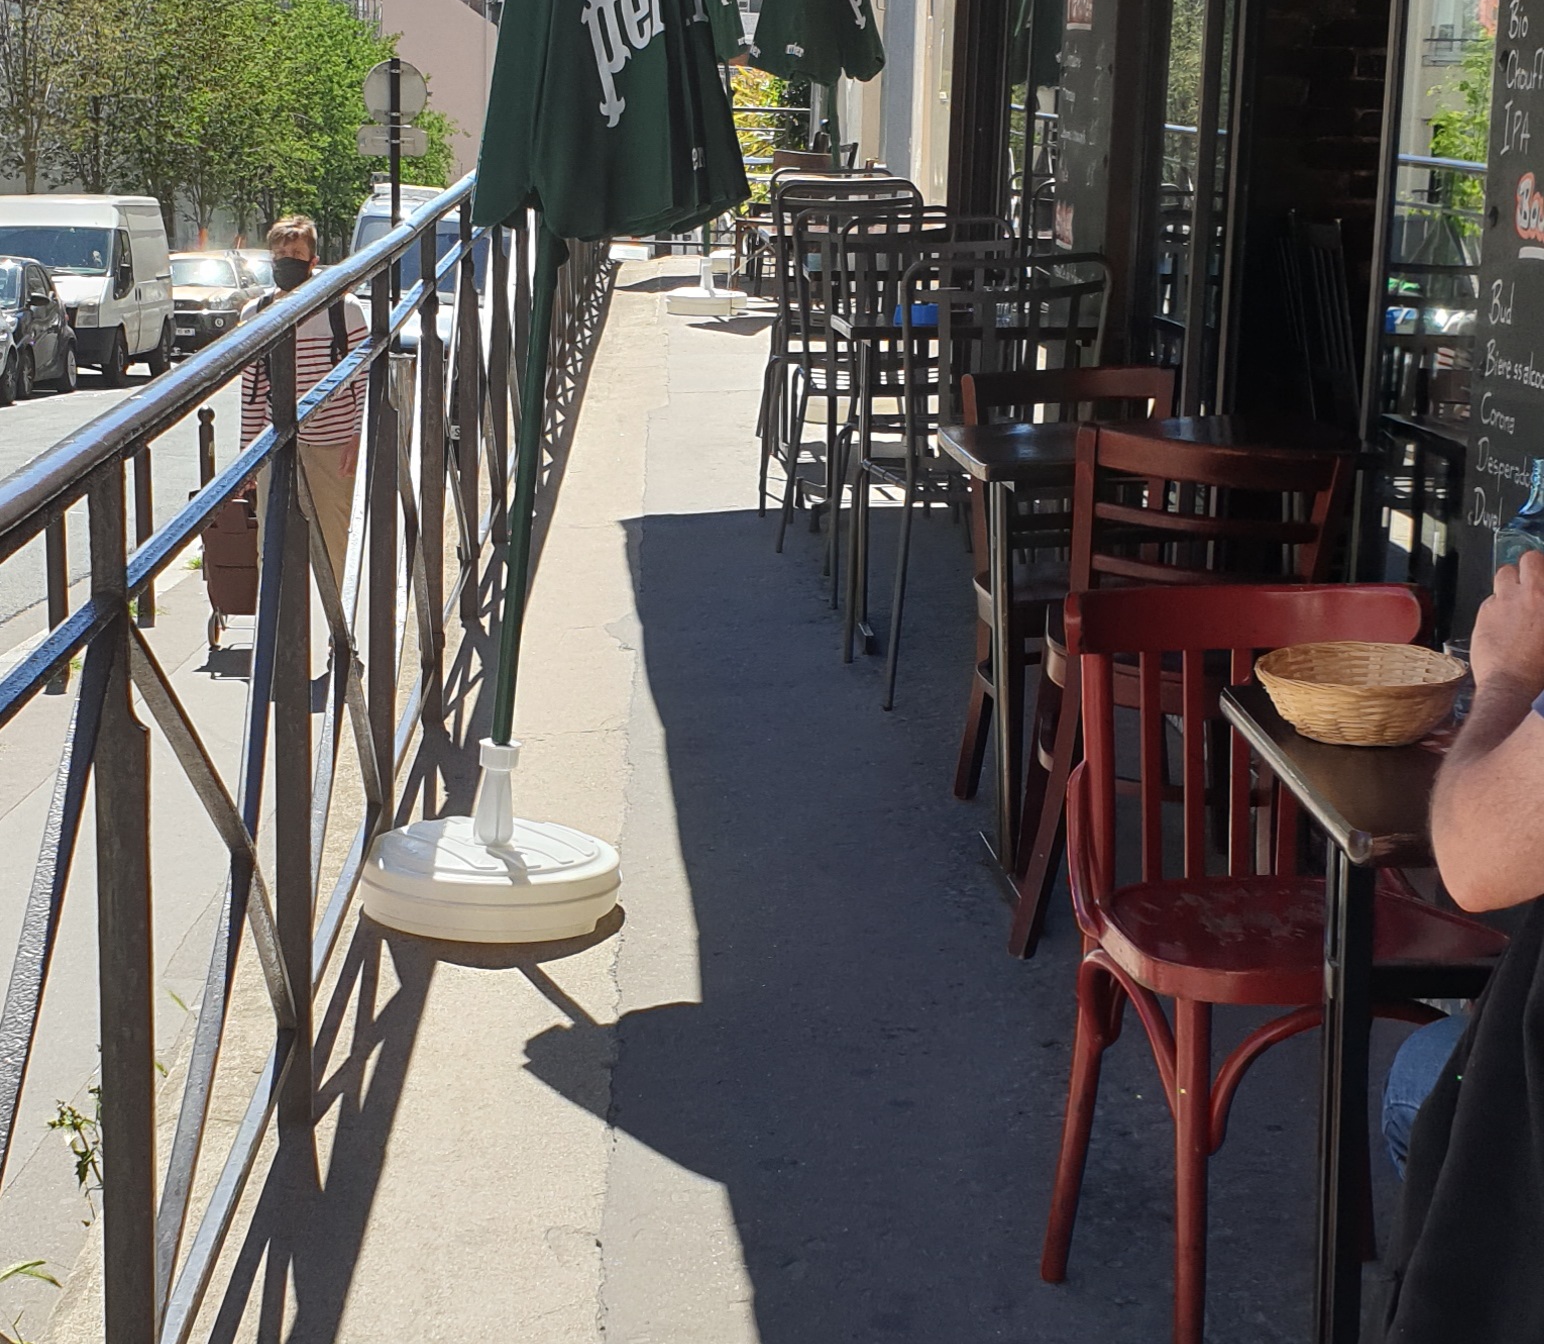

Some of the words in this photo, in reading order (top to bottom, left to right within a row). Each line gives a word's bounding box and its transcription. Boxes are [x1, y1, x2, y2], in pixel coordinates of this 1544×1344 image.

[1500, 100, 1531, 155] IPA
[1488, 278, 1515, 325] Bud
[1480, 391, 1516, 434] Corona
